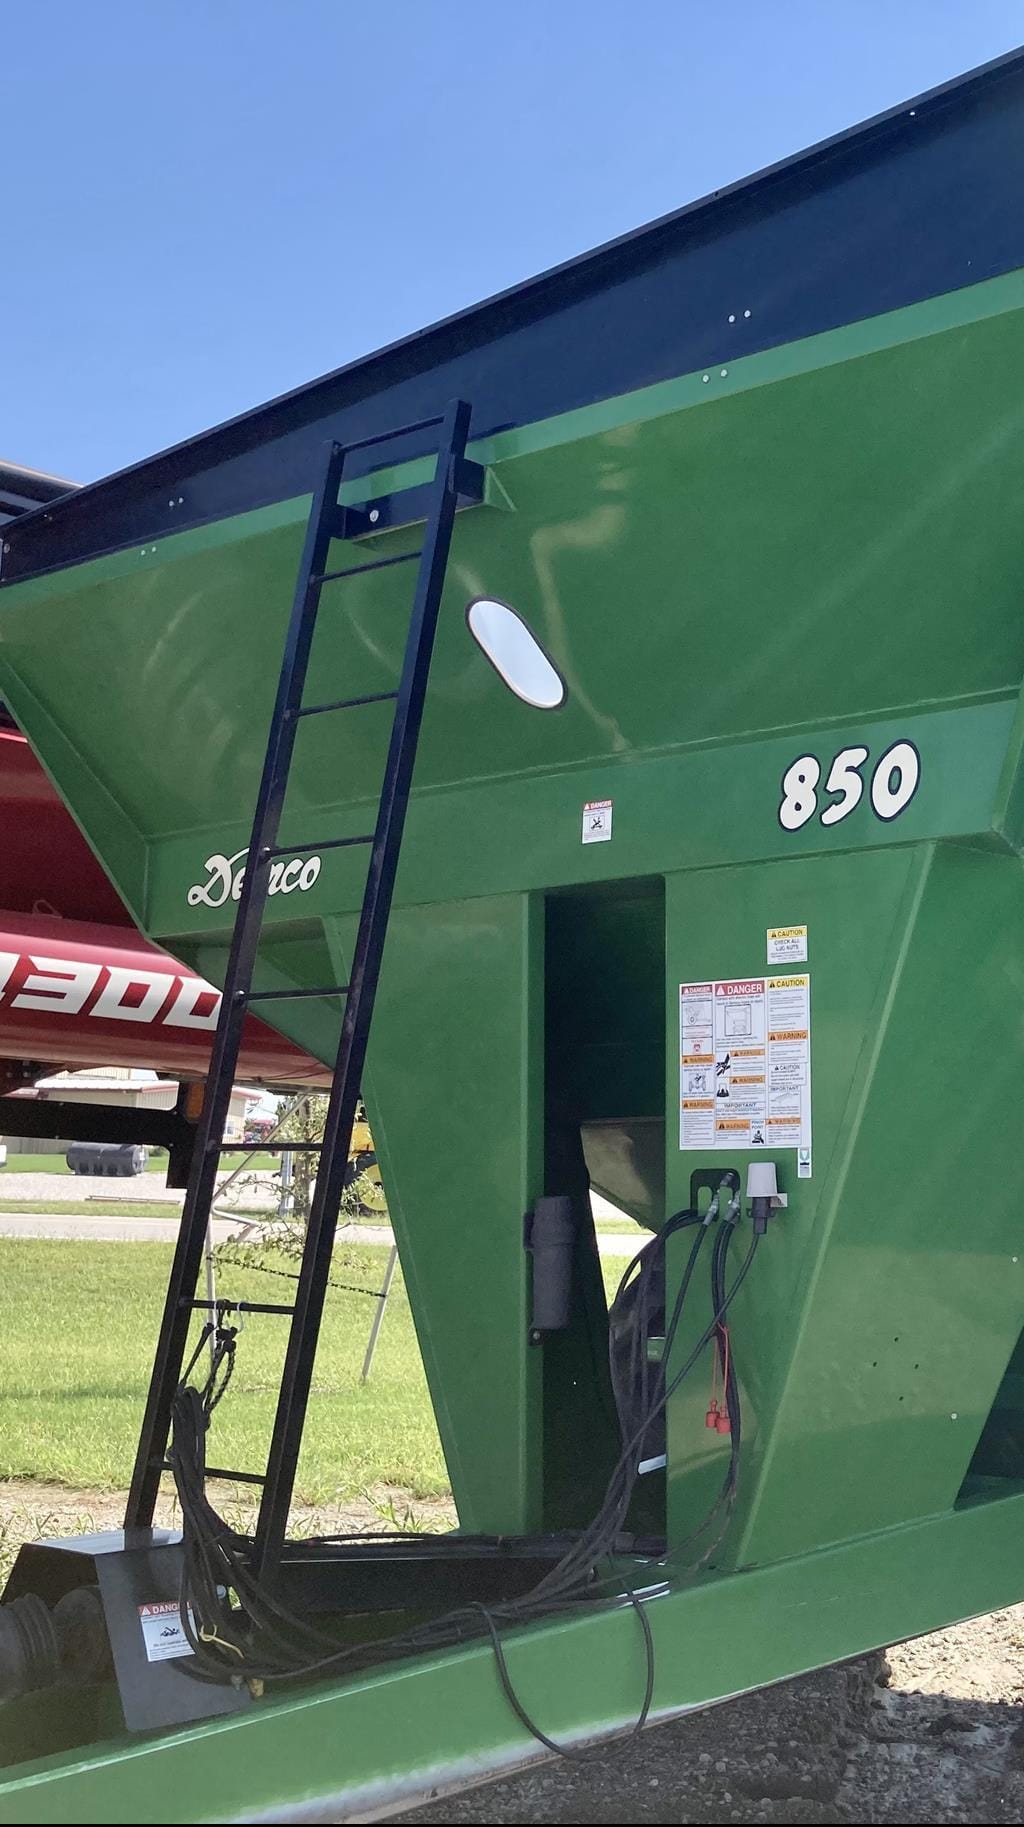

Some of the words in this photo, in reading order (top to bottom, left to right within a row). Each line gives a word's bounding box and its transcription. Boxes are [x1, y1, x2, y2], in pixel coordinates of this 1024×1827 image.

[778, 738, 921, 832] 850
[591, 800, 612, 810] DANGER
[777, 929, 803, 938] CAUTION
[776, 979, 805, 988] CAUTION
[727, 984, 762, 995] DANGER
[777, 1032, 807, 1041] WARNING
[152, 1601, 191, 1614] DANG
